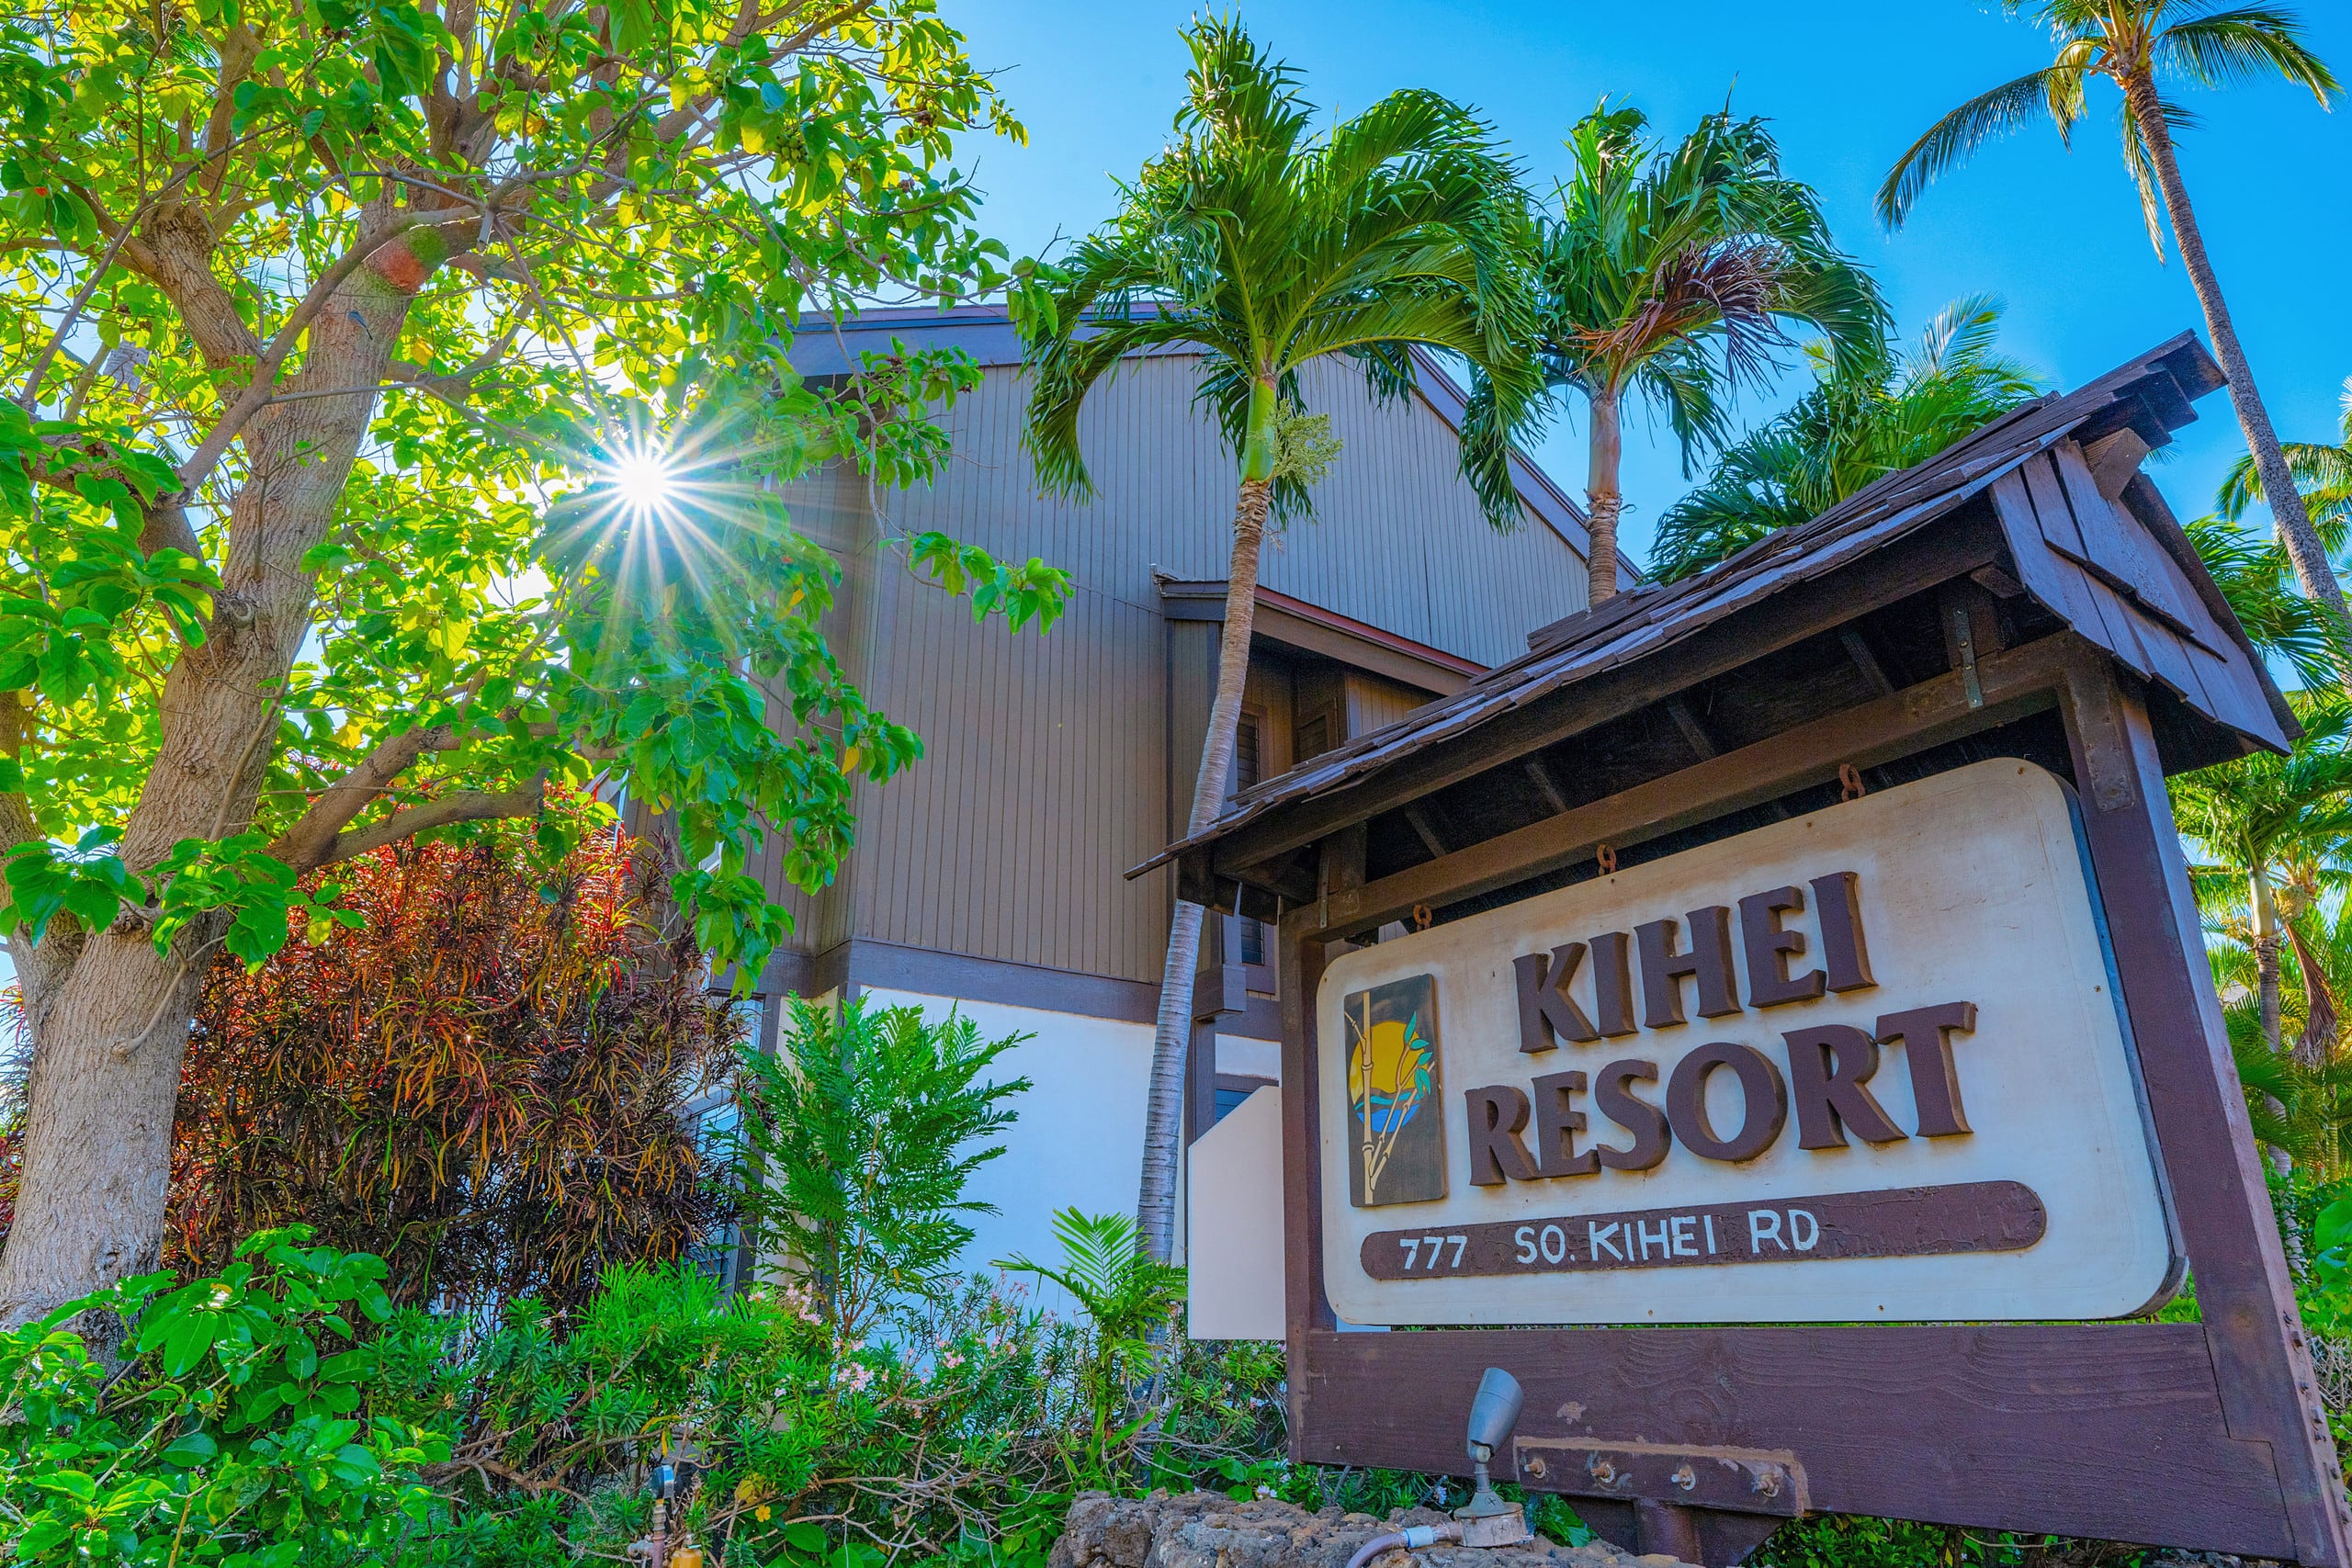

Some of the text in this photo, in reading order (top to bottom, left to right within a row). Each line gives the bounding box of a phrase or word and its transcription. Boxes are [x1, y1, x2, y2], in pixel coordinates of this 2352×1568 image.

[1513, 871, 1878, 1053] KIHEI
[1464, 1001, 1977, 1187] RESORT
[1399, 1209, 1820, 1269] 777 SO. KIHEI RD
